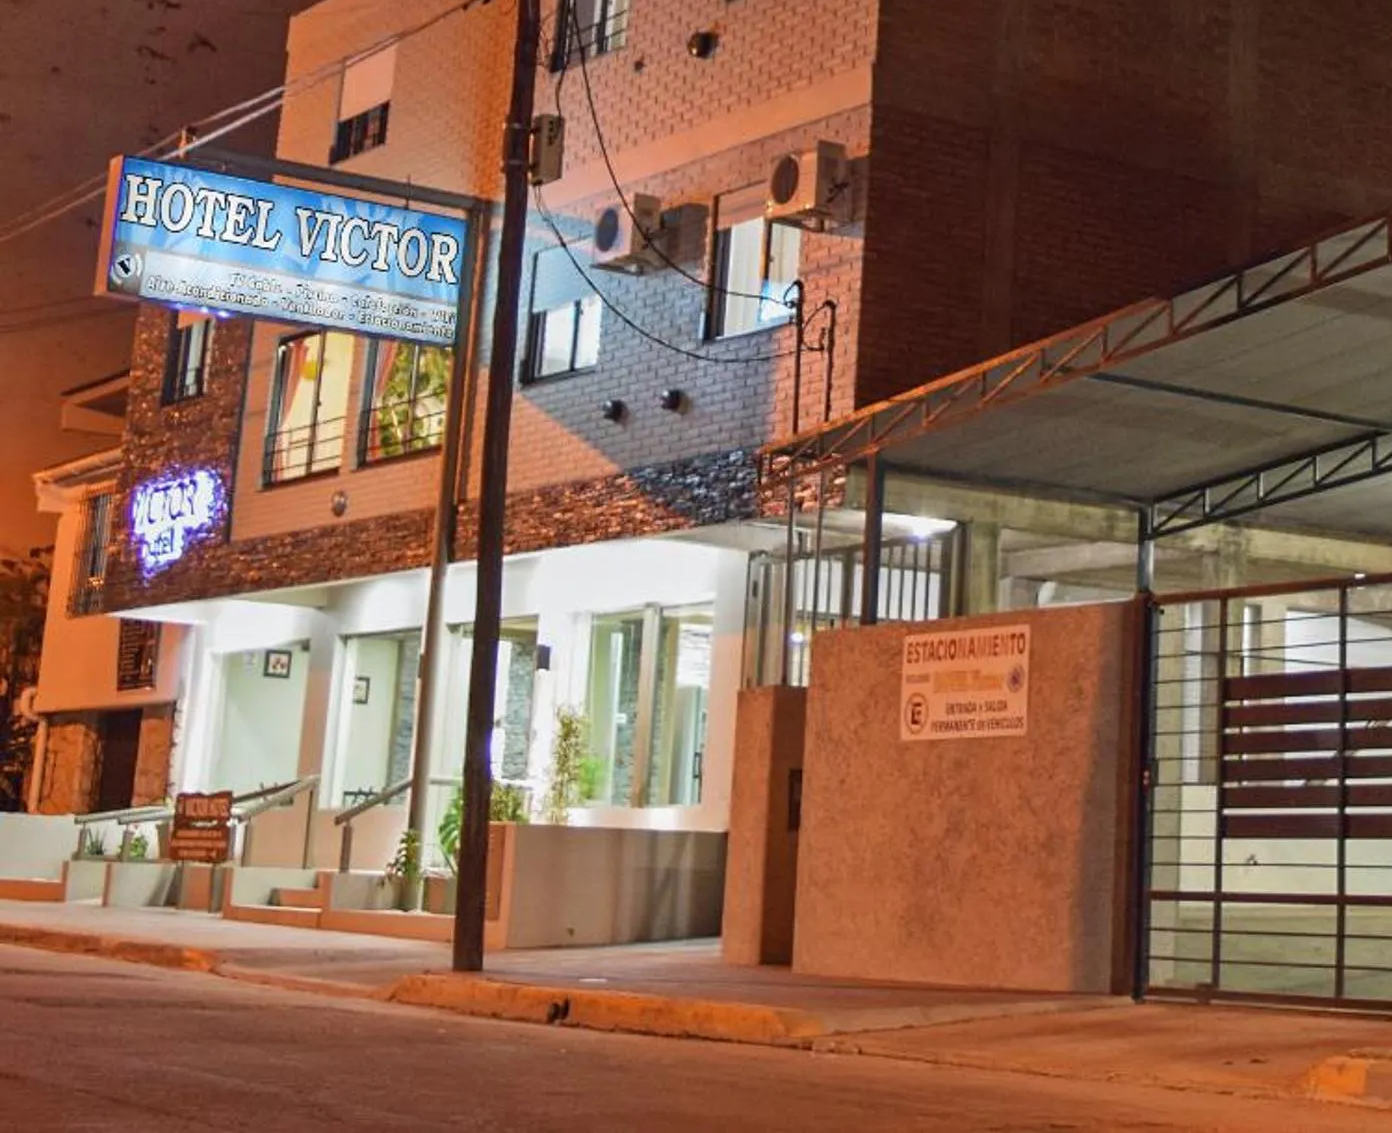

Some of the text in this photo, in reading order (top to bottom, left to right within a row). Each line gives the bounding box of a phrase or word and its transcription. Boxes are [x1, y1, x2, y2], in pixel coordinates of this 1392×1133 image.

[121, 173, 461, 285] HOTEL VICTOR
[906, 633, 1026, 664] ESTACIONAMIENTO
[911, 702, 922, 725] E
